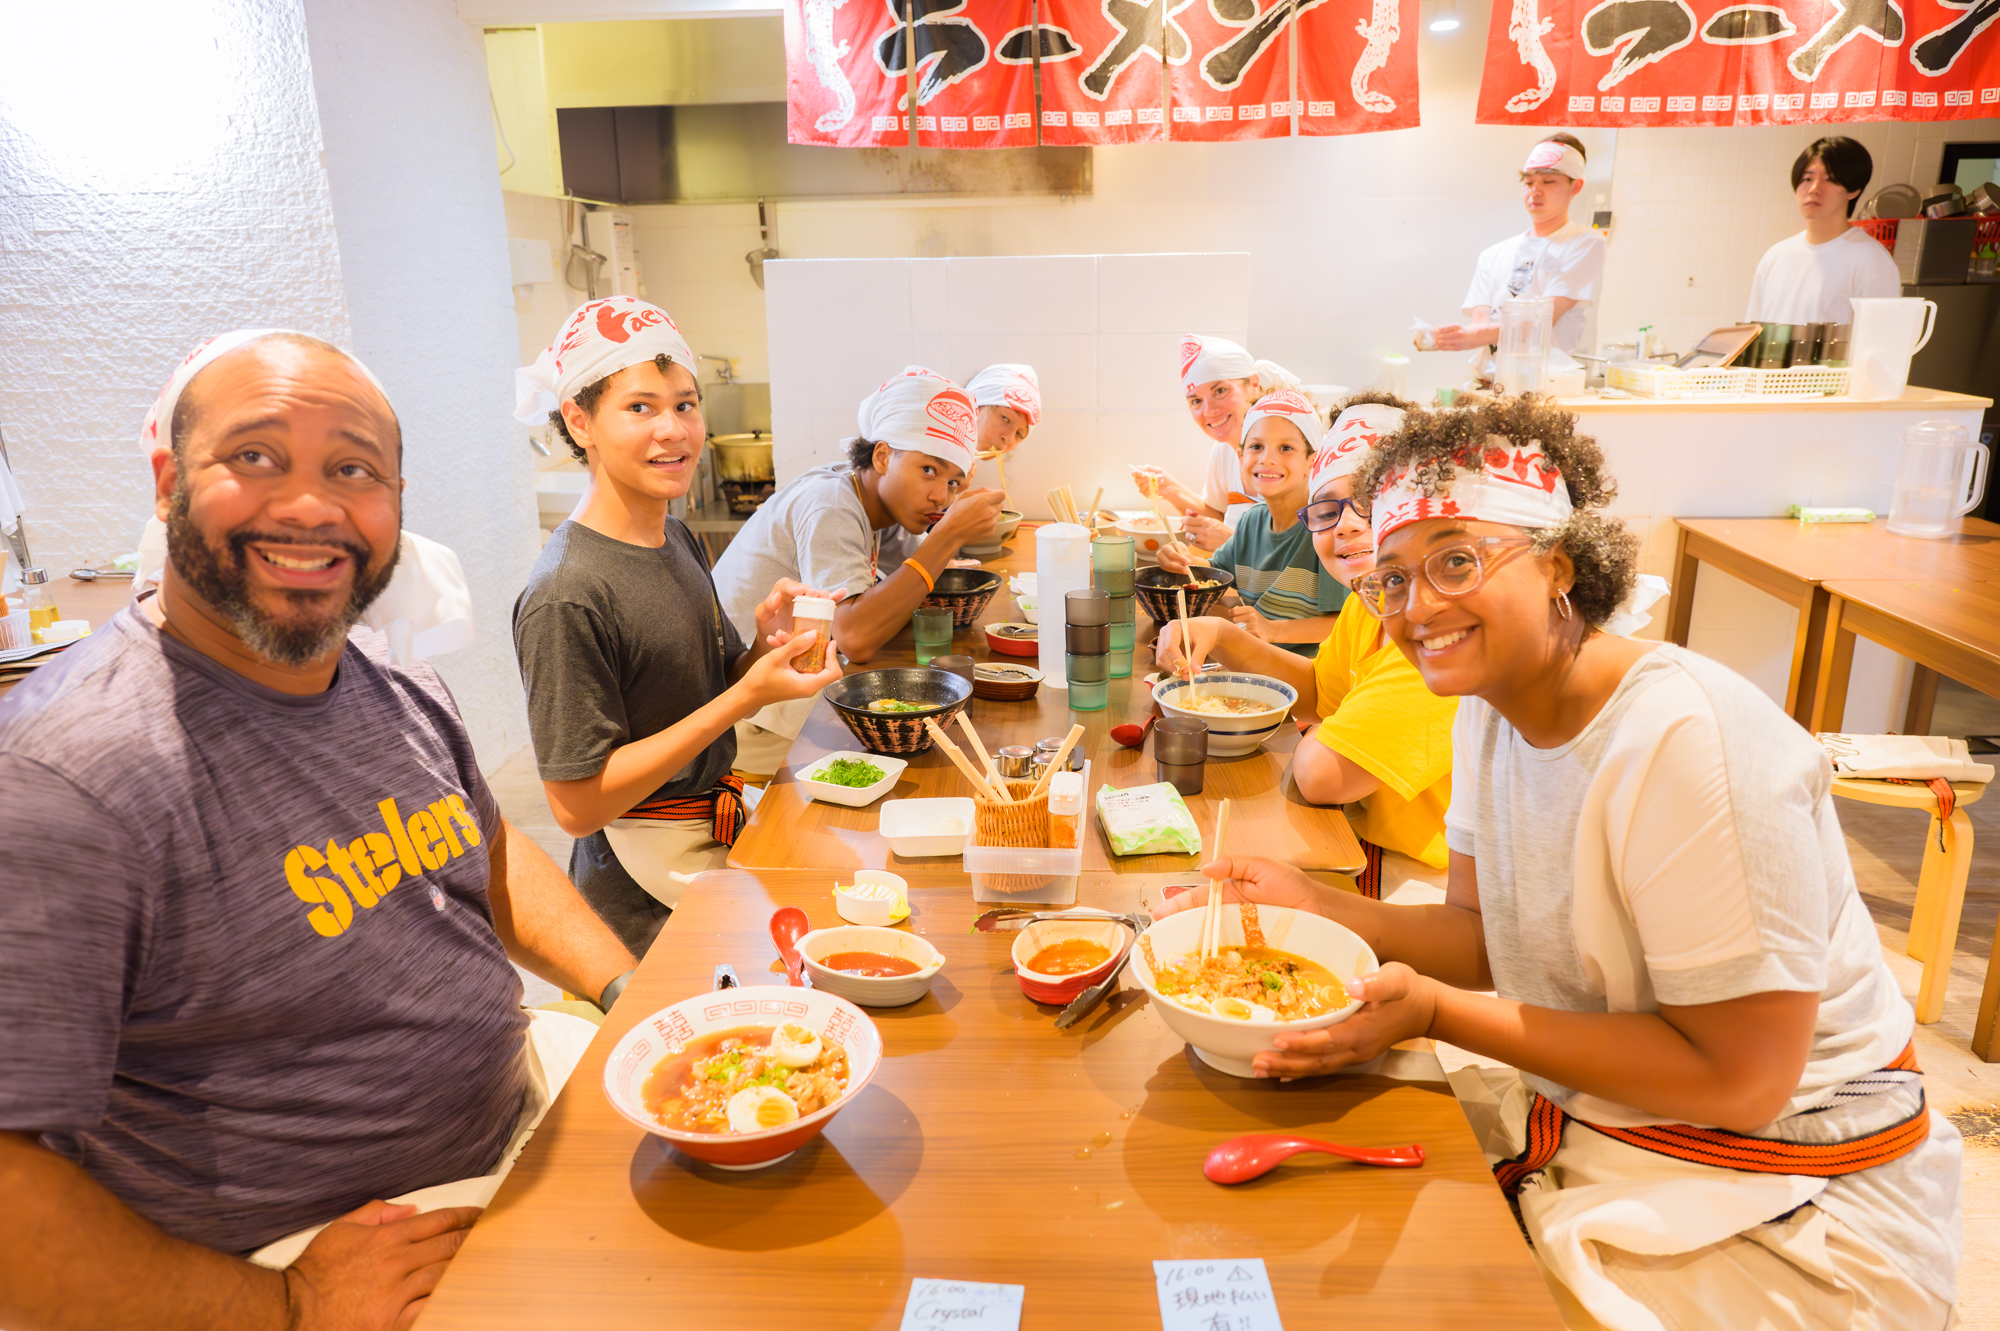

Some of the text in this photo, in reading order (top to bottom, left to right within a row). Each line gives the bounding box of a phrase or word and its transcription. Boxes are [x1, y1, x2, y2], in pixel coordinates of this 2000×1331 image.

[1164, 1266, 1215, 1286] 16:00
[917, 1284, 966, 1298] 16:00
[914, 1299, 986, 1324] Crystal
